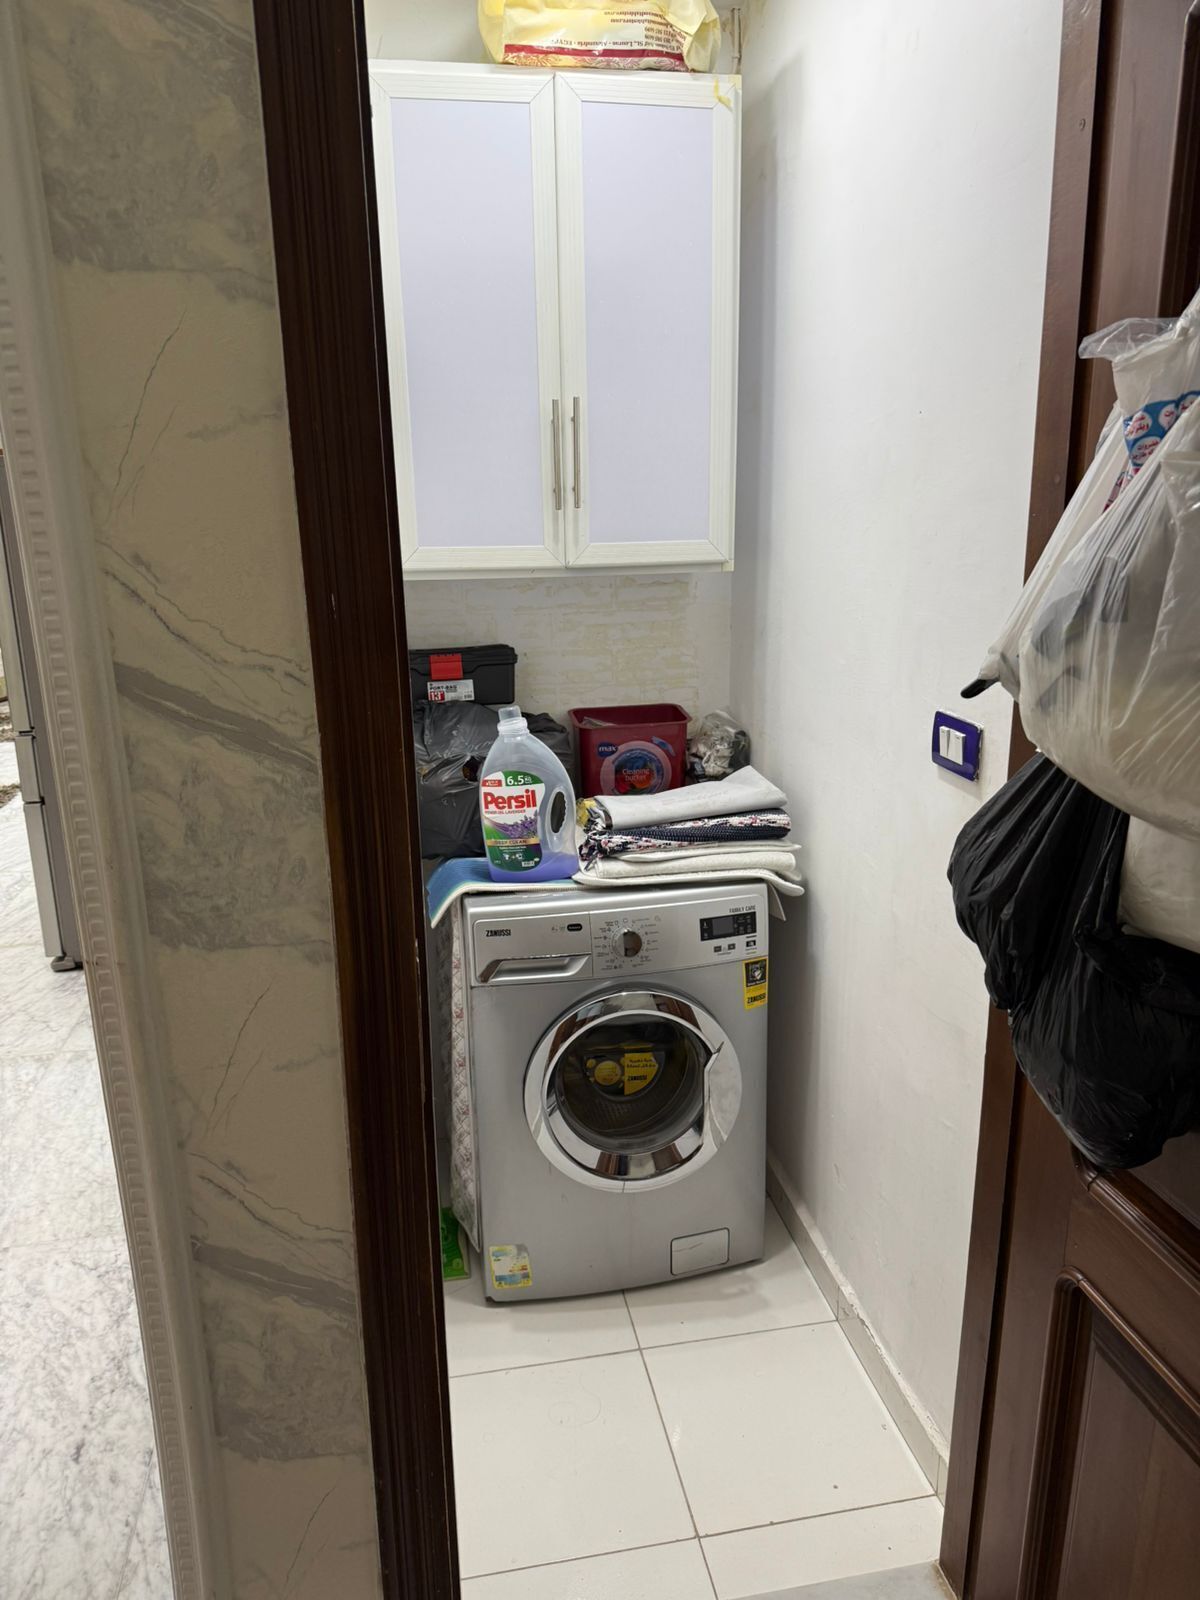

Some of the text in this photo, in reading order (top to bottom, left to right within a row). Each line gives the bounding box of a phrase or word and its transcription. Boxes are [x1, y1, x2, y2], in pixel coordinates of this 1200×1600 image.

[506, 775, 525, 786] 6.5
[625, 774, 648, 782] bucket
[483, 788, 537, 810] Persil
[485, 929, 511, 937] ZANUSSI
